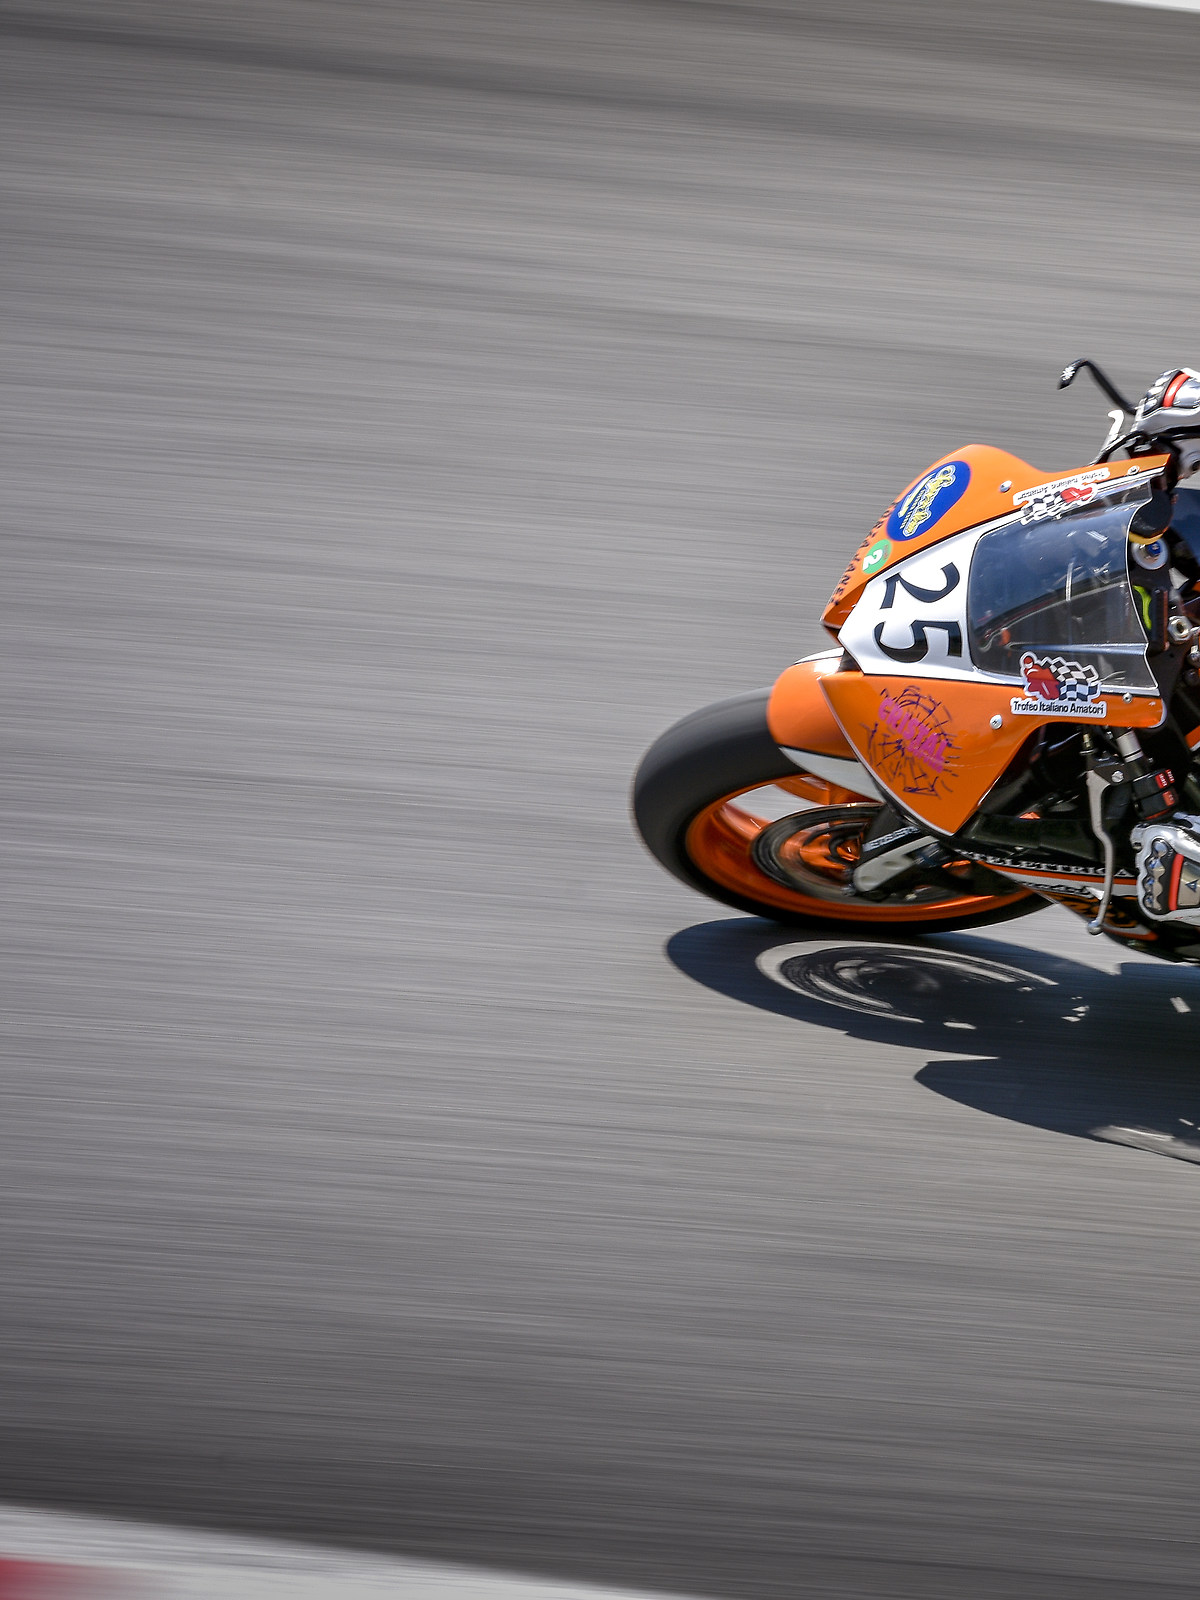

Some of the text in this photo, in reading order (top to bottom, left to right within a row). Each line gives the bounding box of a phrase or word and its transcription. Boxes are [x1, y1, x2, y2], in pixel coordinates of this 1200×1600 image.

[862, 549, 883, 571] 2
[874, 562, 963, 663] 25
[1013, 700, 1104, 715] Trofeo Italiano Amatori
